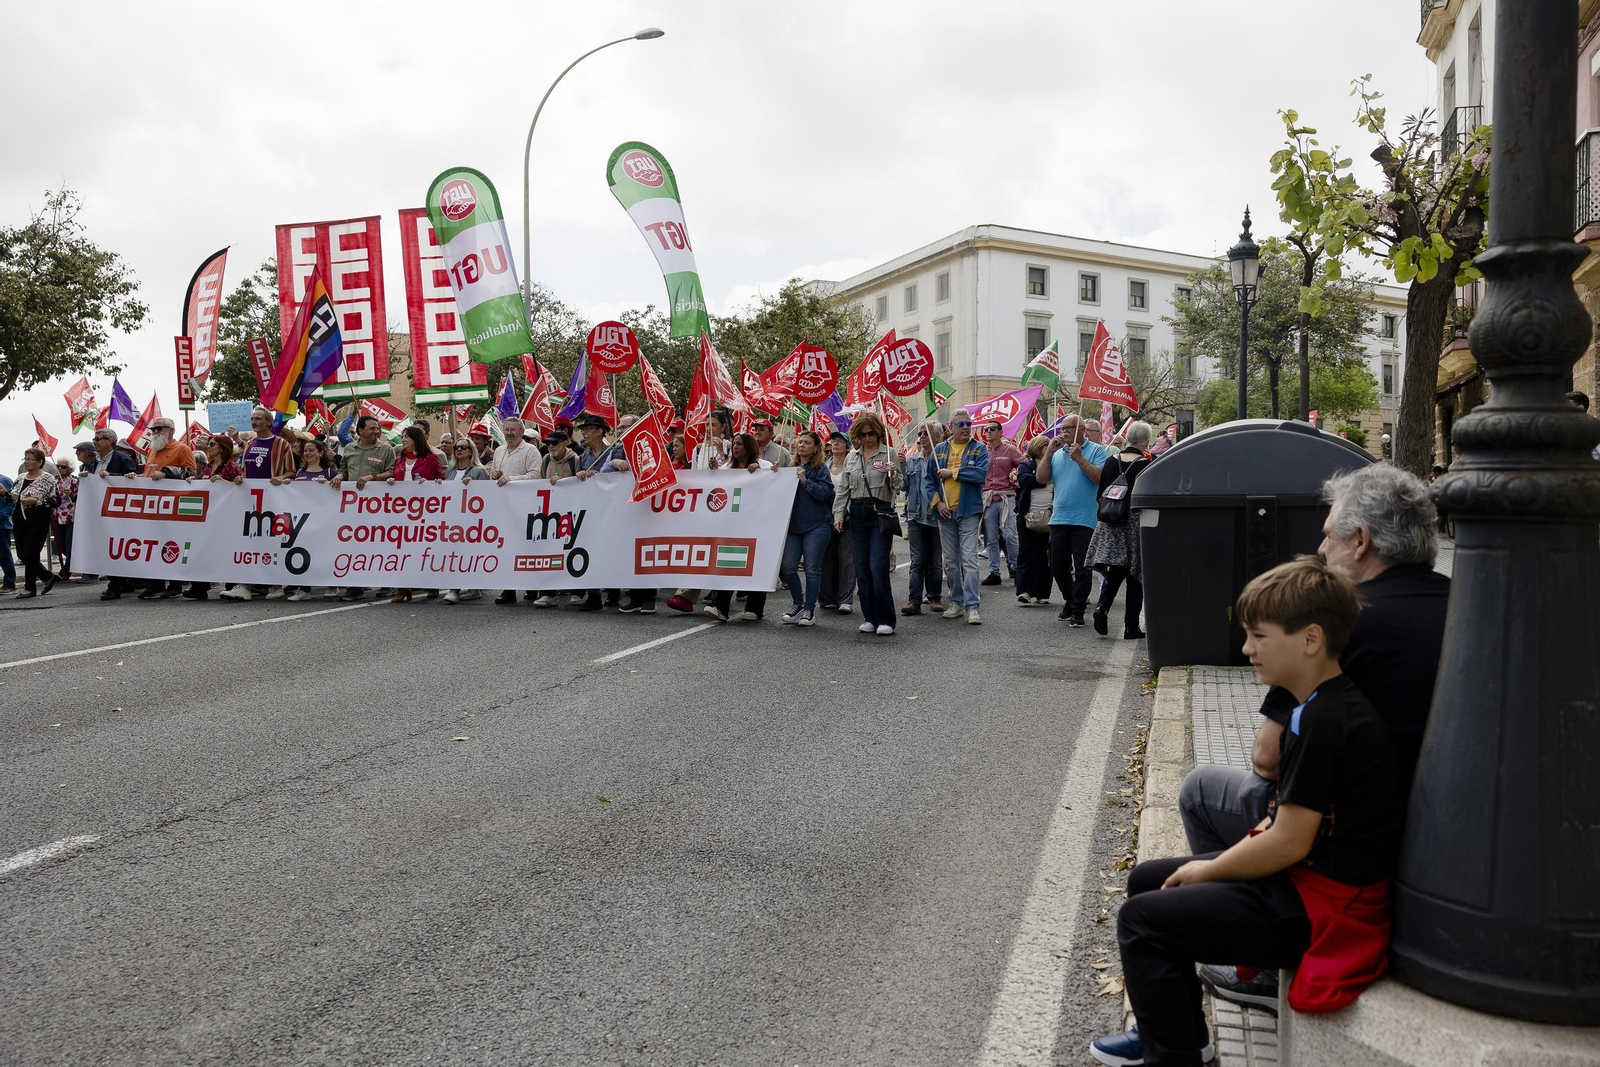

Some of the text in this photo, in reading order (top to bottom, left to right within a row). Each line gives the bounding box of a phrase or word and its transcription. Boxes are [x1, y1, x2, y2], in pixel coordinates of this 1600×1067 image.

[328, 220, 376, 383] CCOO
[193, 273, 219, 378] CCOO
[594, 327, 630, 347] UGT
[178, 340, 192, 398] CCOO
[801, 351, 828, 374] GT
[882, 339, 922, 375] UGT
[107, 493, 175, 515] CCOO
[340, 488, 485, 520] Proteger lo
[650, 488, 704, 513] UGT
[337, 518, 504, 549] conquistado,
[108, 536, 159, 562] UGT
[233, 551, 261, 565] UGT
[333, 547, 499, 577] ganar futuro
[640, 544, 711, 567] CCOO
[516, 557, 550, 569] CCOO
